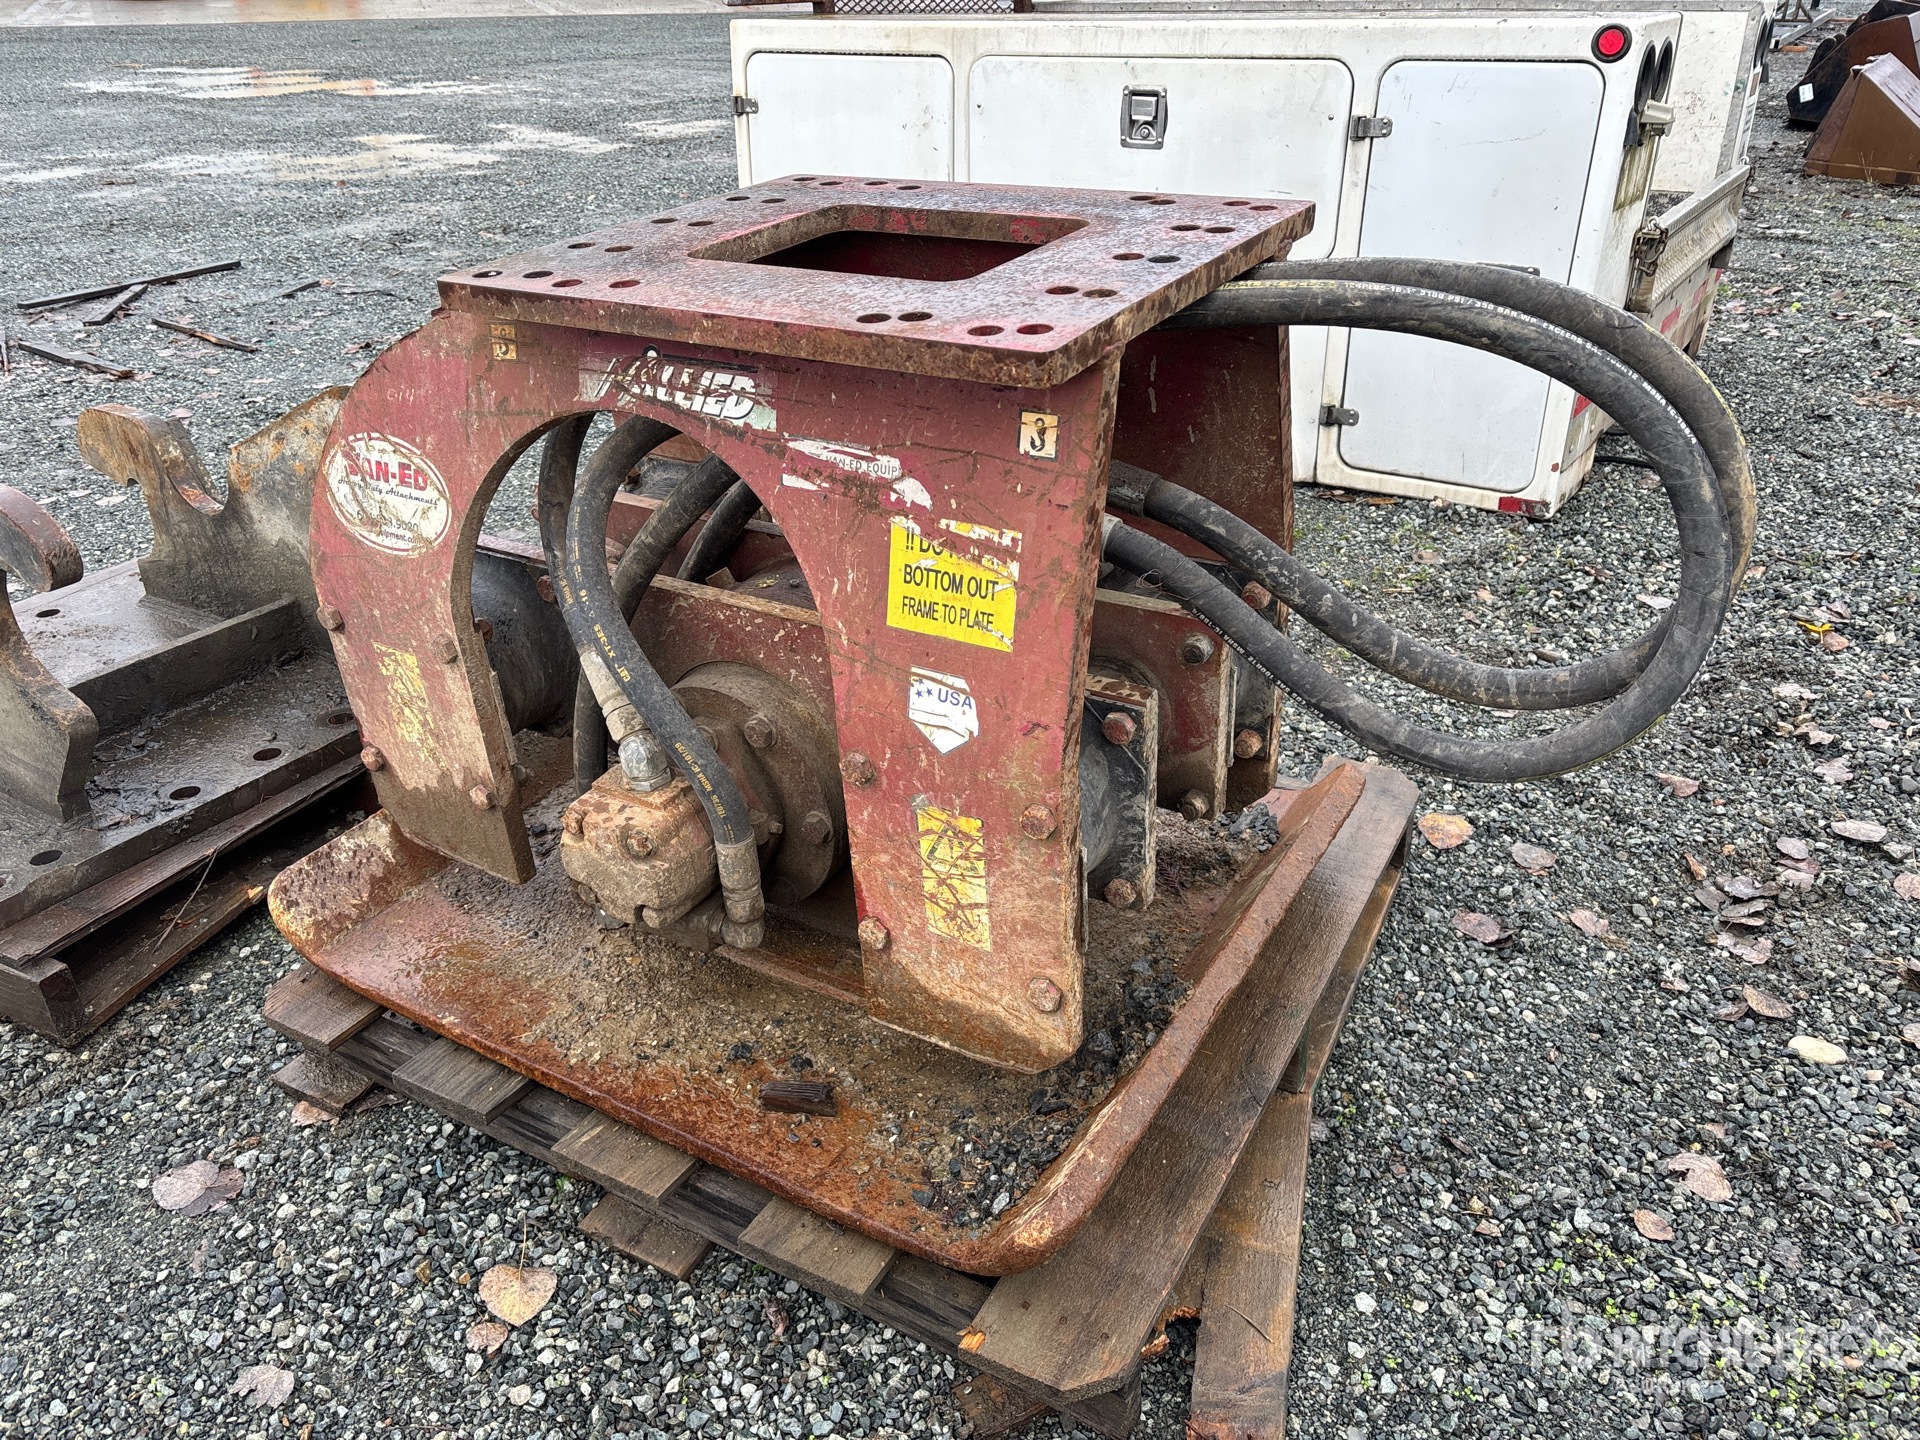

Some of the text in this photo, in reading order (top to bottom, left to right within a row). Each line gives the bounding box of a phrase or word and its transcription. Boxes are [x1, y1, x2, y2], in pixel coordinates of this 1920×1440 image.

[1447, 295, 1464, 303] PSI
[1474, 301, 1493, 310] 350
[1641, 381, 1667, 406] MSHA
[903, 563, 999, 601] BOTTOM OUT
[901, 595, 995, 633] FRAME TO PLATE
[593, 623, 616, 659] XT-3ES
[1222, 633, 1246, 654] MSHA
[937, 688, 972, 710] USA
[697, 771, 713, 793] MSHA
